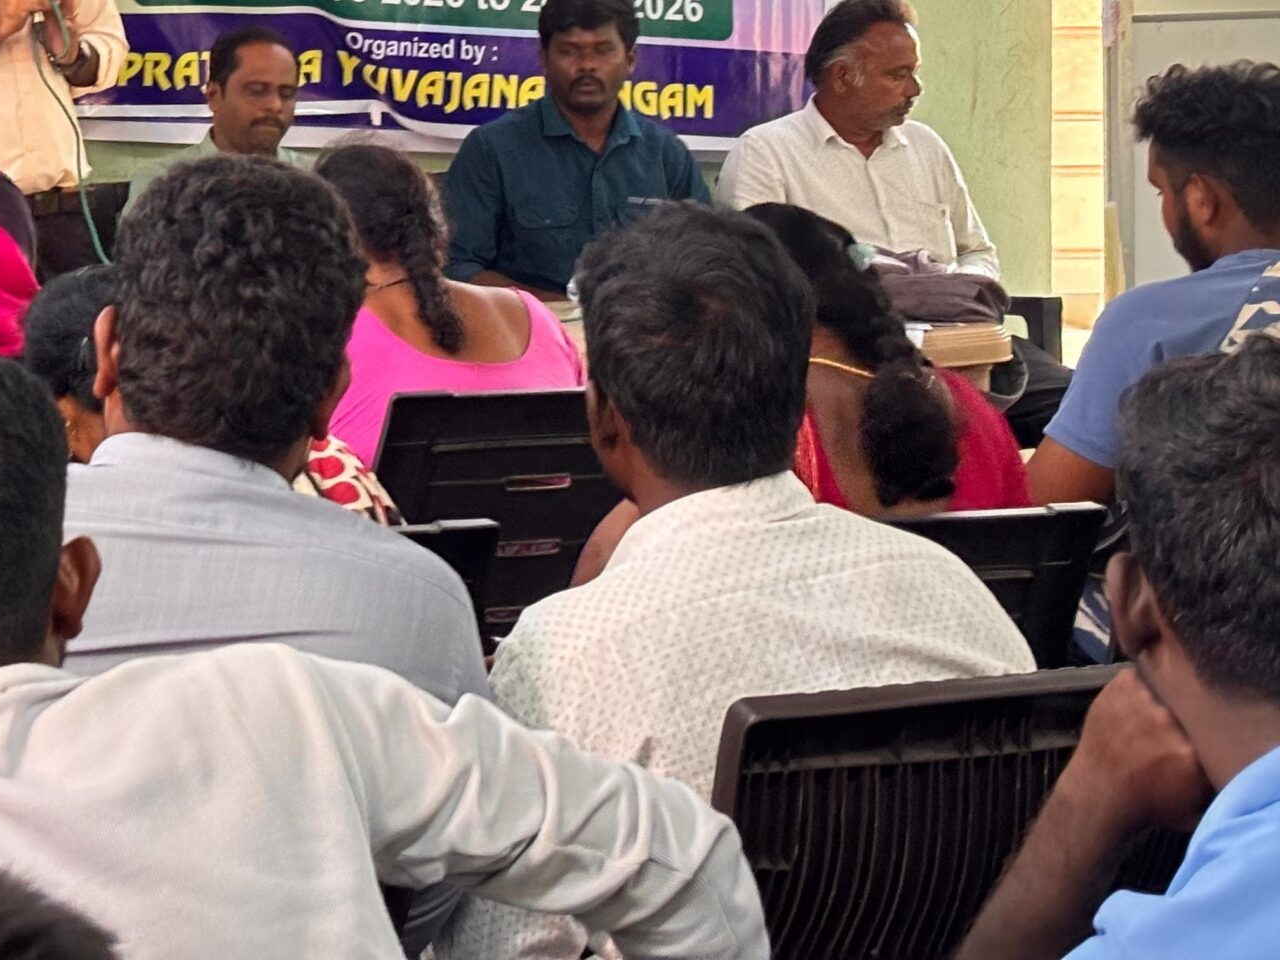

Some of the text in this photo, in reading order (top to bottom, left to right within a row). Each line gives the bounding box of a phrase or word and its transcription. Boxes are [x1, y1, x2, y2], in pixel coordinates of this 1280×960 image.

[345, 32, 456, 61] Organized
[460, 41, 486, 66] by
[336, 50, 547, 114] YUVAJANA
